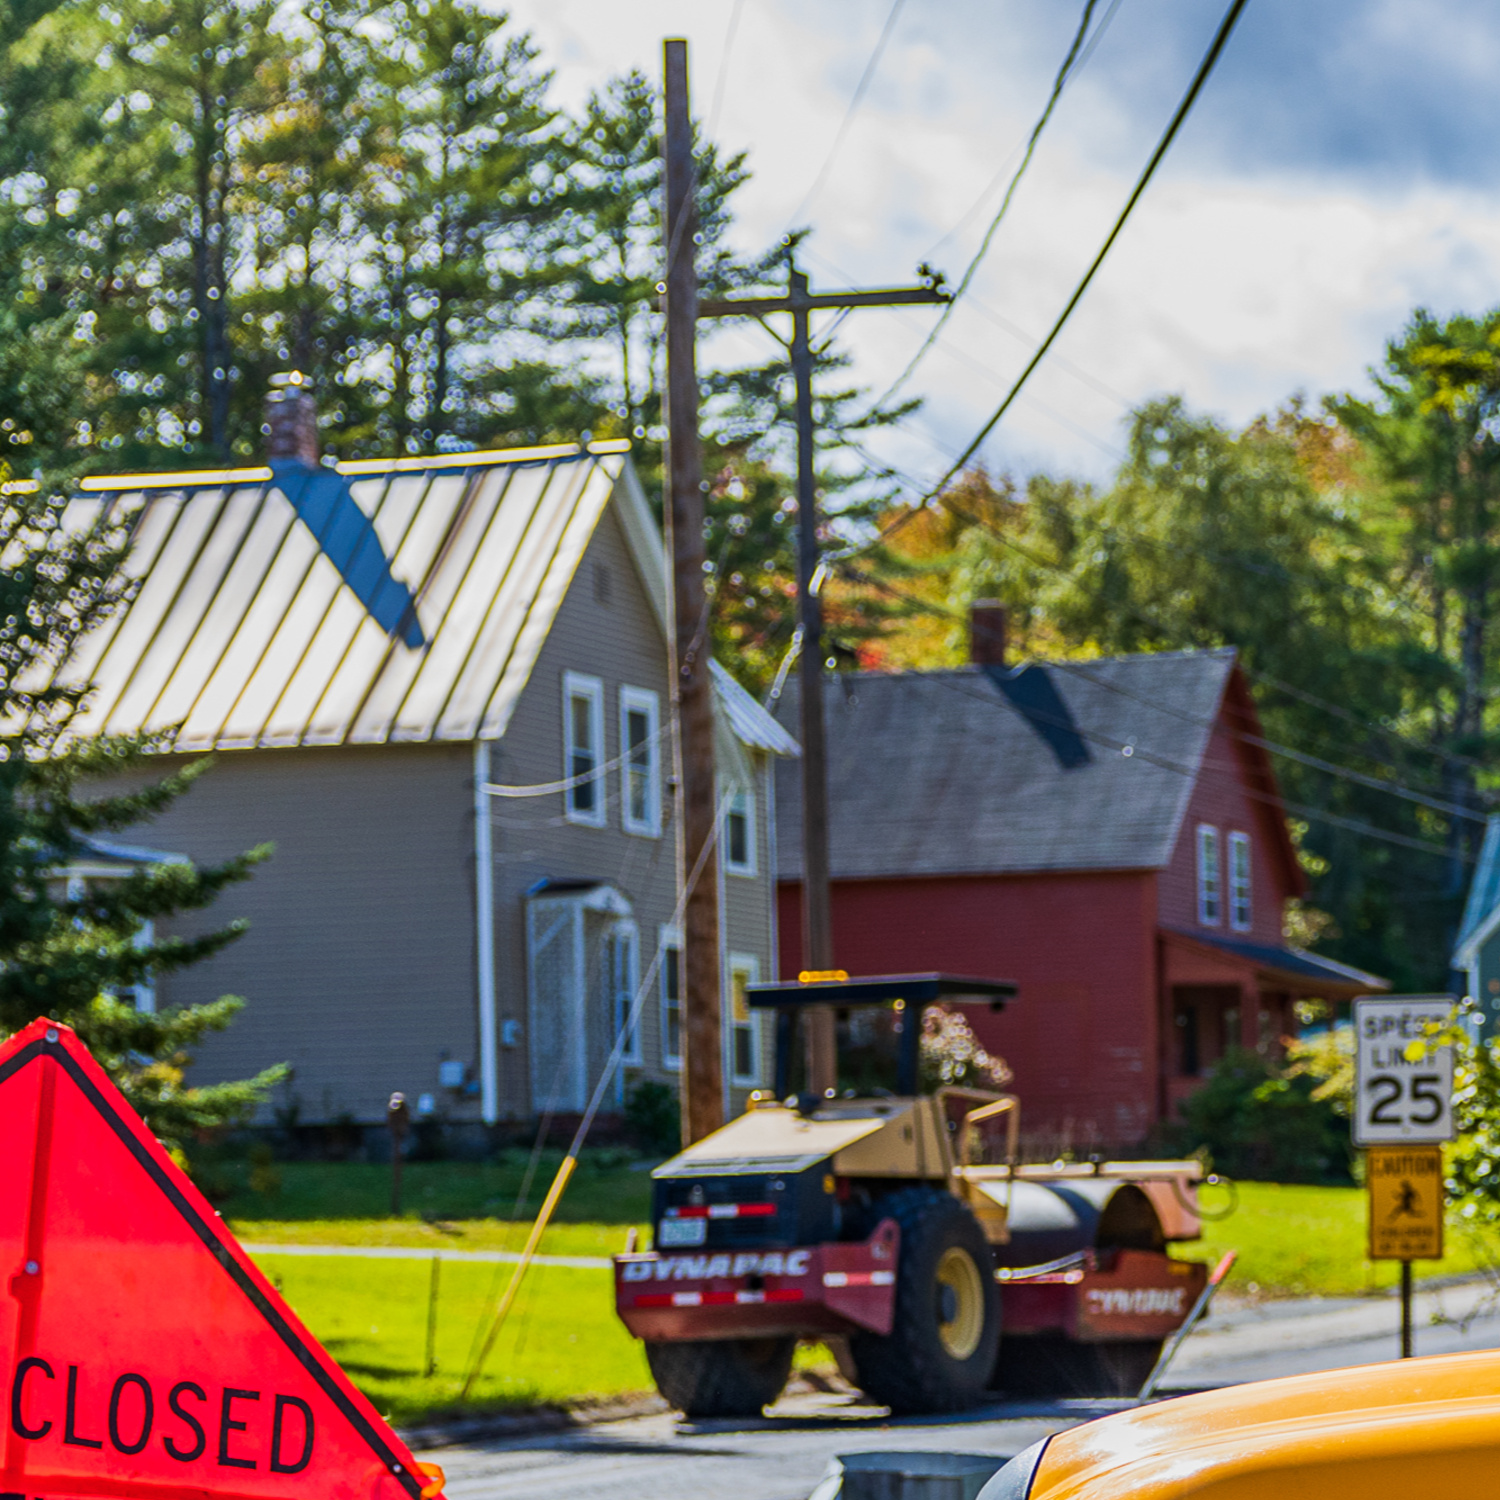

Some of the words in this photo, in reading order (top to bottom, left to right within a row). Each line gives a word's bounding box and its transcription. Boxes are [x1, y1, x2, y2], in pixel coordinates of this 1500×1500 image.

[1364, 1014, 1445, 1039] SPE
[1371, 1047, 1438, 1068] LIM
[1366, 1074, 1444, 1125] 25
[622, 1250, 811, 1281] DYNAPAC
[12, 1355, 316, 1474] CLOSED
